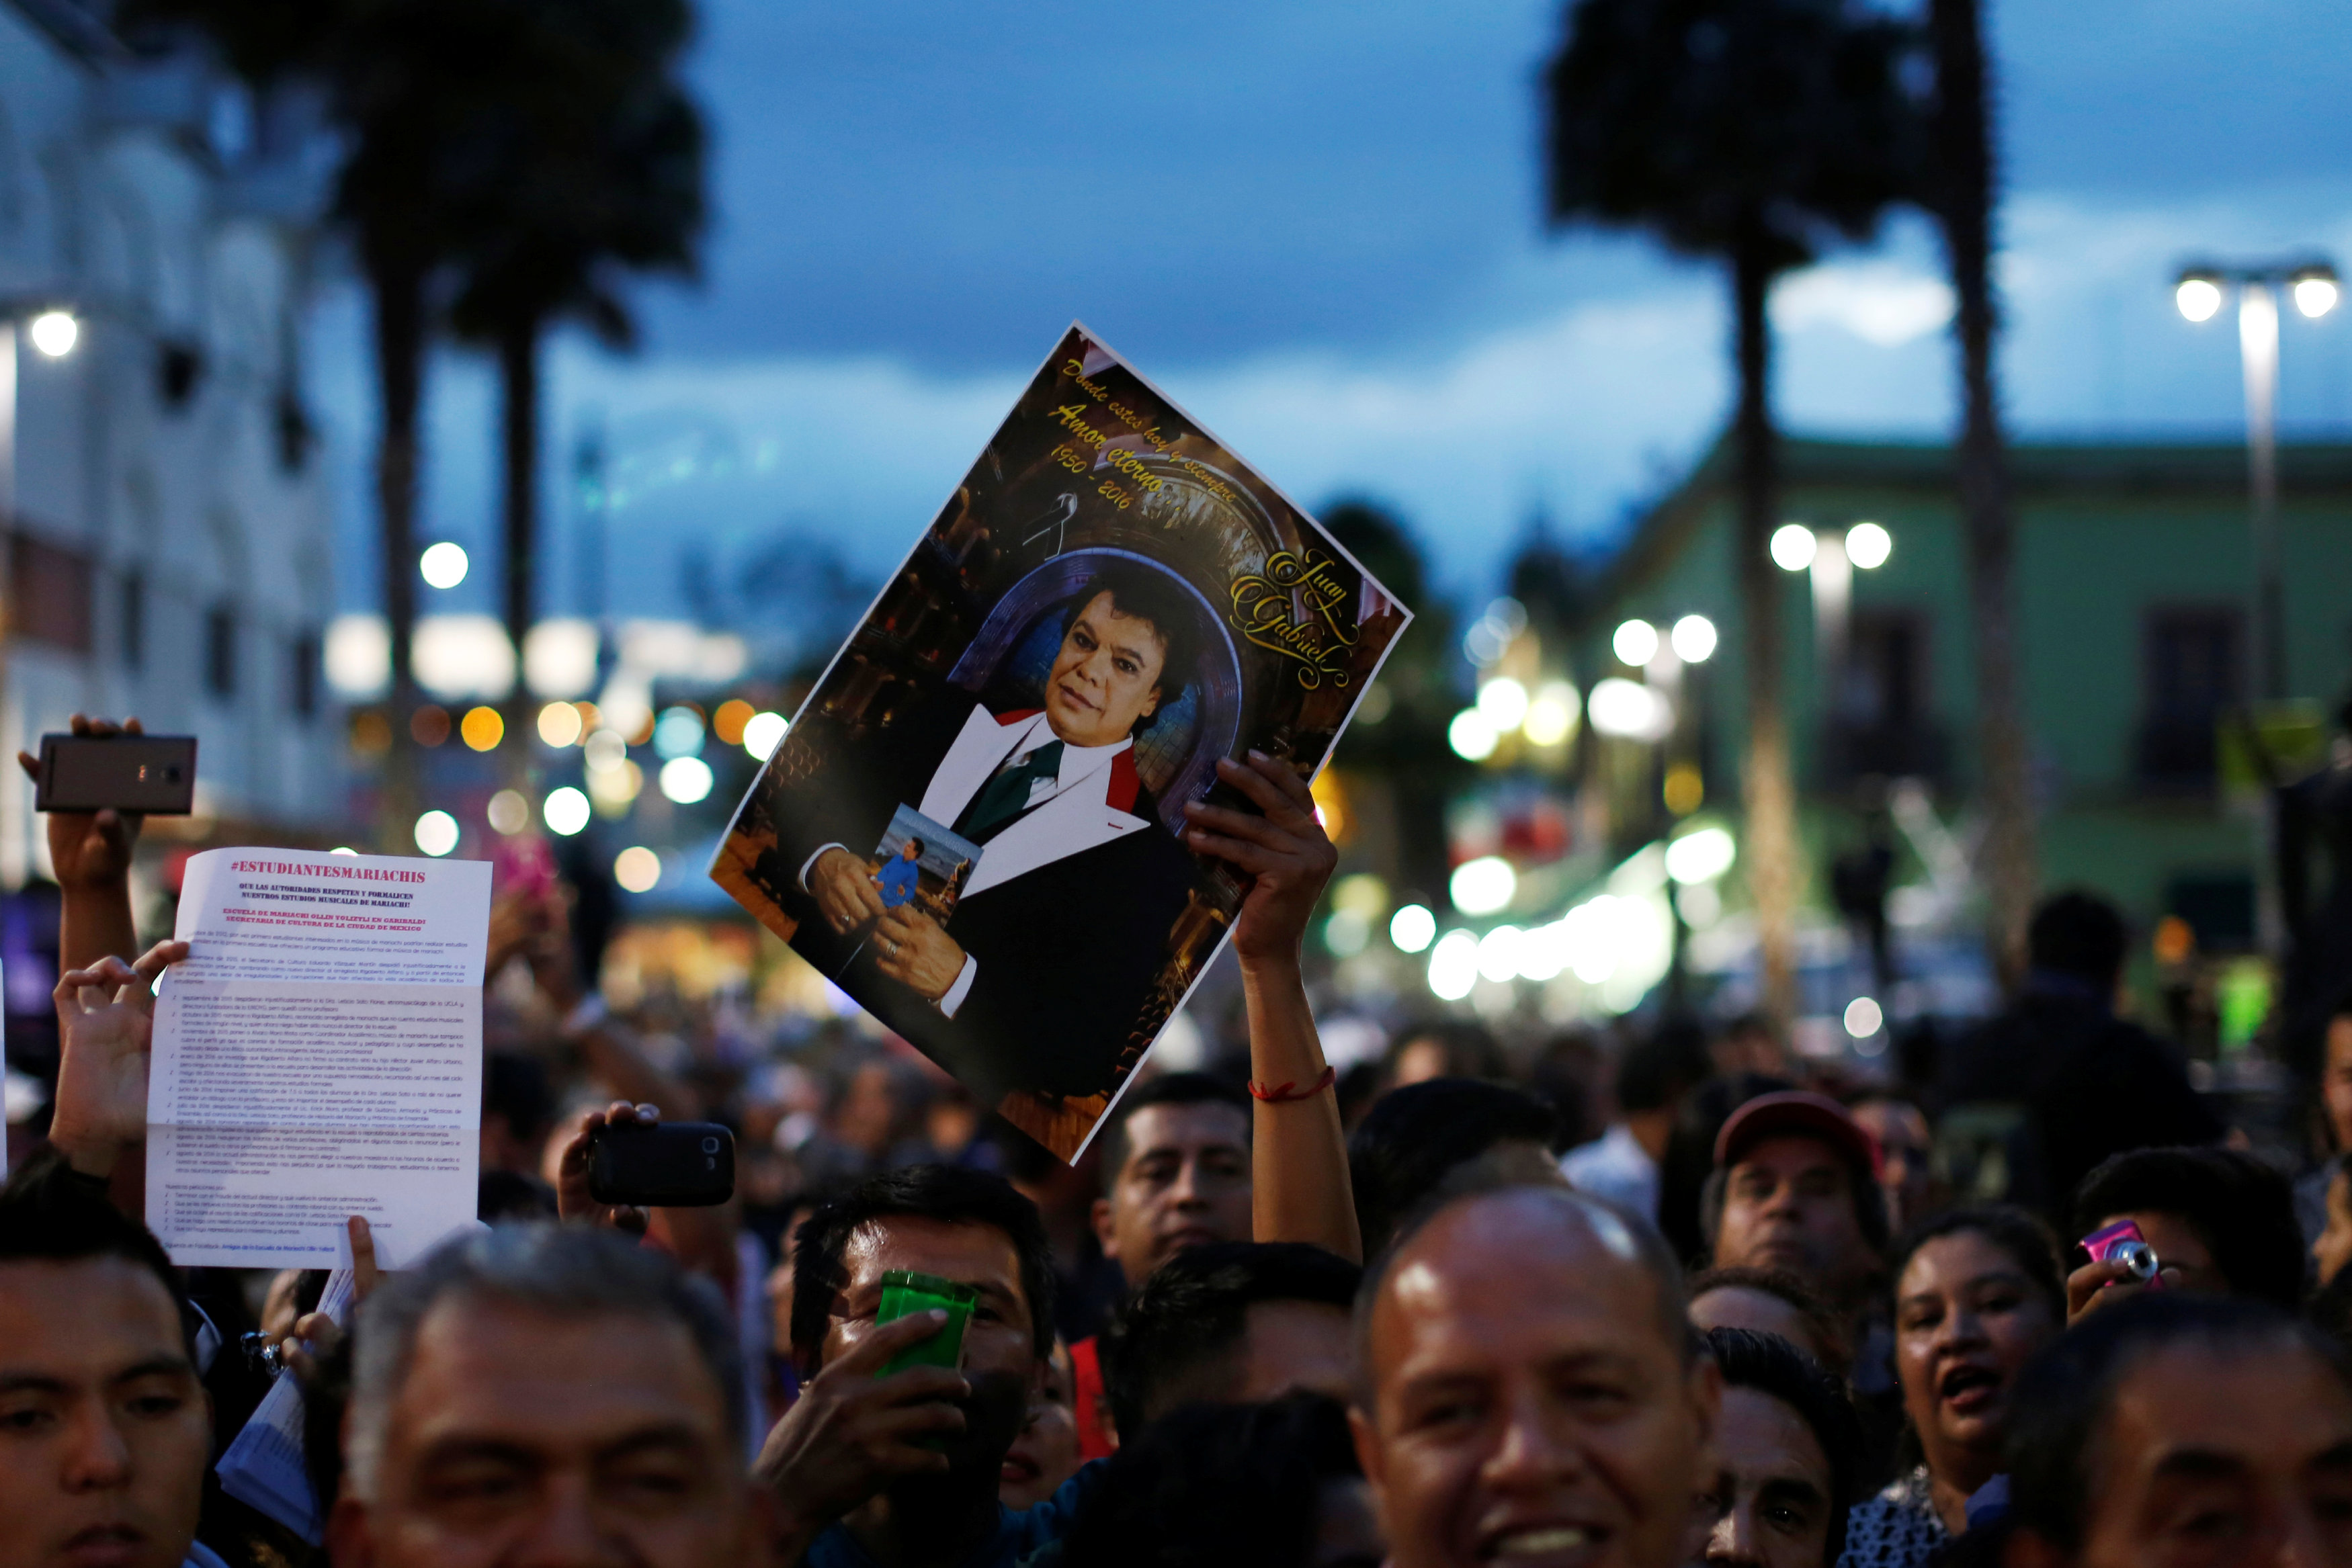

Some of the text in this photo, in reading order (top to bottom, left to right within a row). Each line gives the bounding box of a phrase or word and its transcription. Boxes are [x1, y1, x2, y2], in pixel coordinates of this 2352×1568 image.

[1048, 404, 1107, 450] Amor
[1063, 359, 1107, 401] Donde
[1144, 427, 1169, 453] hoy
[1169, 451, 1182, 462] y
[1185, 460, 1236, 502] siempre
[1051, 444, 1087, 472] 1950
[1098, 480, 1134, 509] 2016
[1267, 549, 1359, 645] Juan
[1230, 576, 1349, 690] Gabriel
[231, 861, 425, 883] #ESTUDIANTESMARIACHIS
[271, 885, 321, 894] AUTORIDADES
[368, 891, 413, 899] FORMALICEN
[319, 896, 358, 904] MUSICALES
